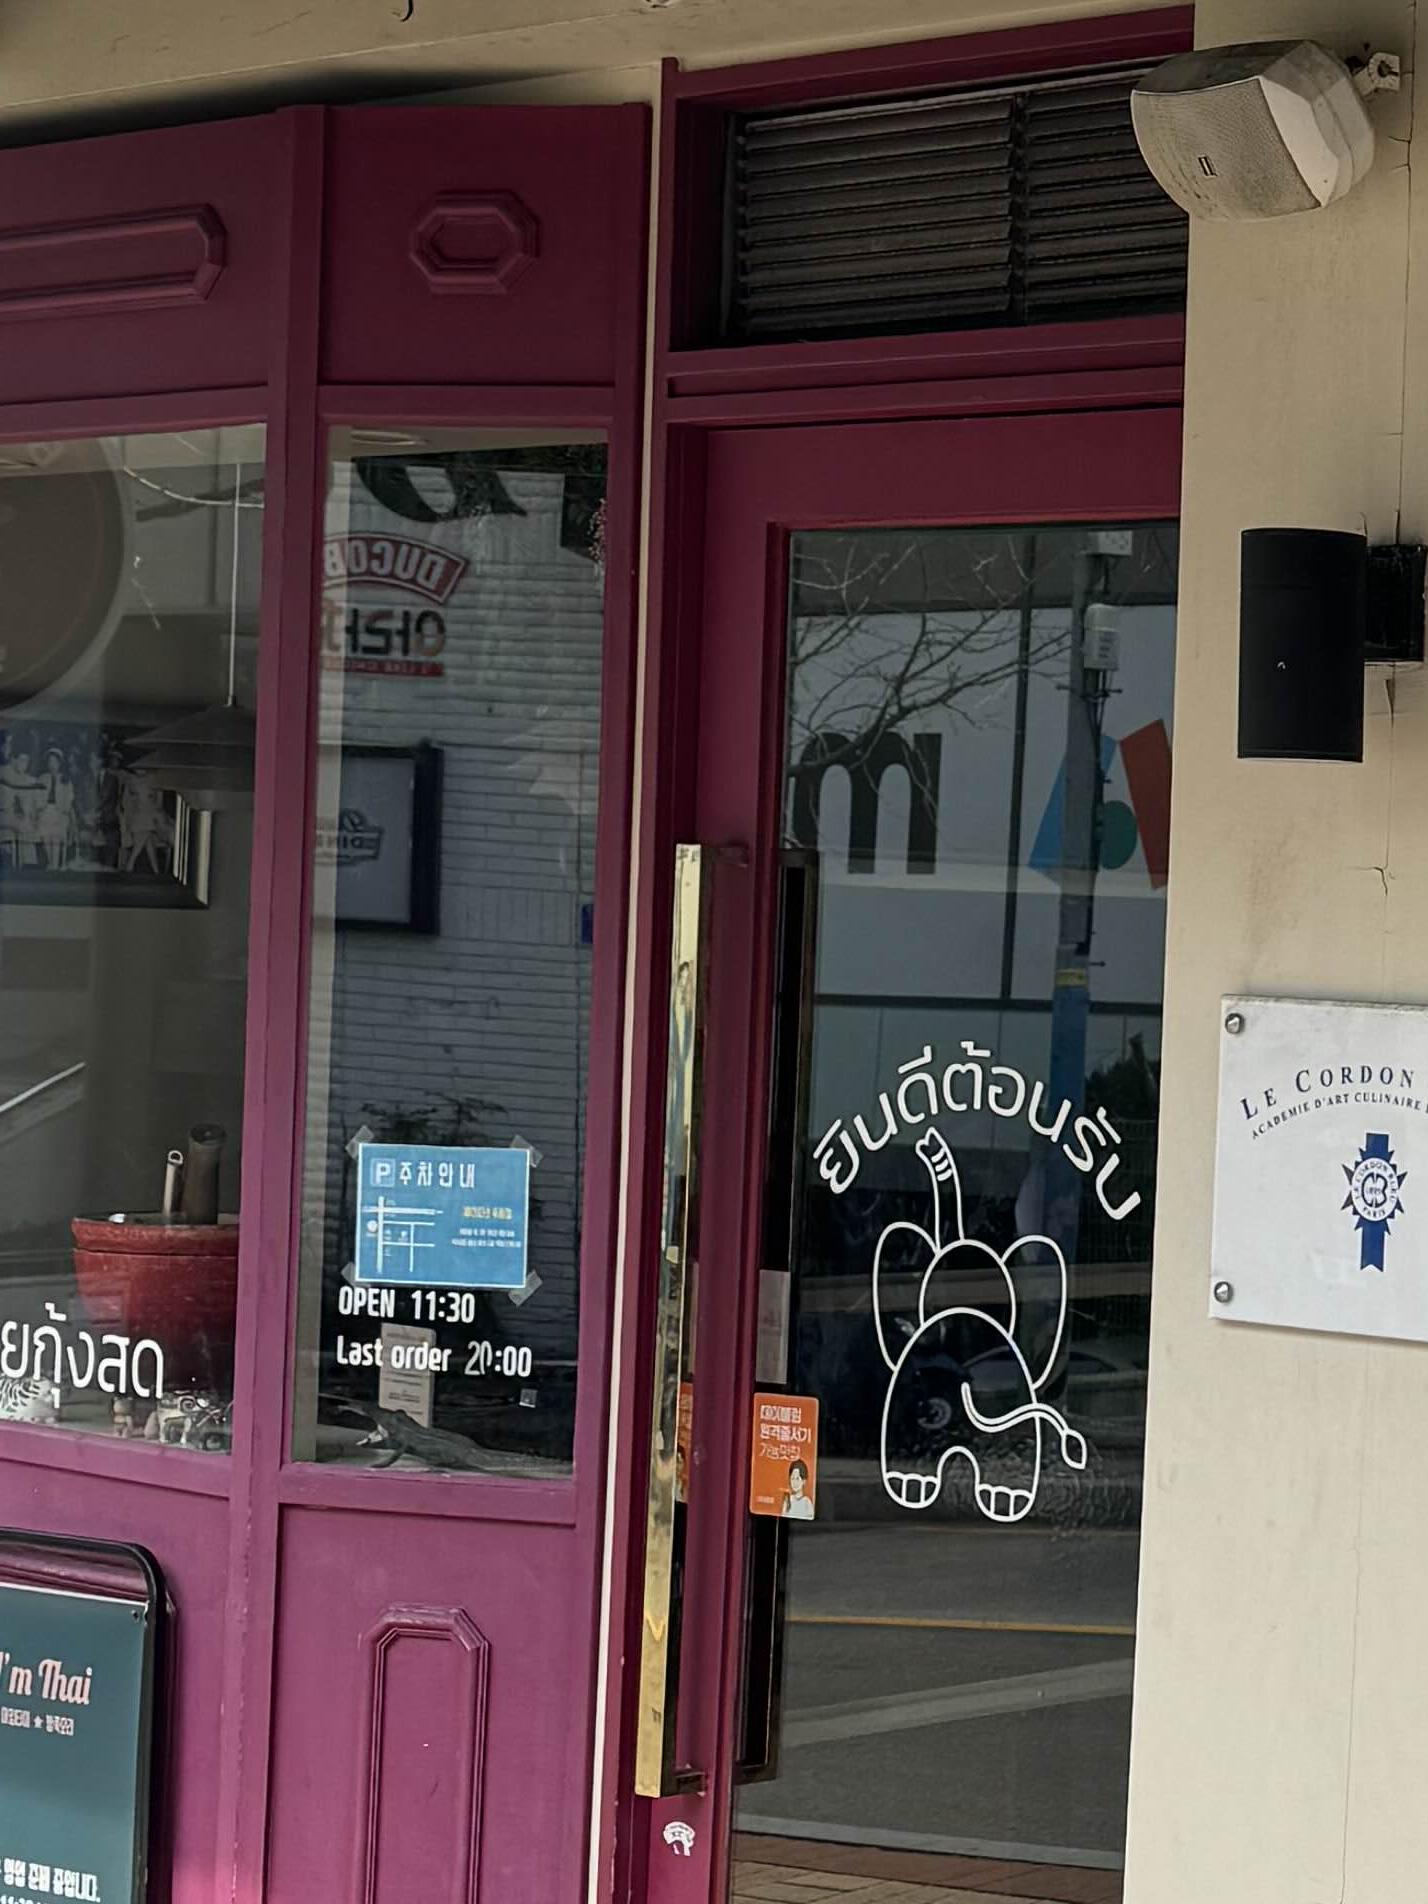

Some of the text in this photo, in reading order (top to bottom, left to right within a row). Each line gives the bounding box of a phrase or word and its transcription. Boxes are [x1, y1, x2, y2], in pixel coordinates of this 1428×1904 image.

[1240, 1088, 1278, 1120] LE
[1295, 1065, 1415, 1093] CORDON
[815, 1041, 1142, 1220] ยินดีต้อนรับ
[338, 1286, 475, 1323] OPEN 11:30
[1, 1302, 165, 1409] ยกุ้งสด
[336, 1335, 384, 1367] Last
[391, 1341, 452, 1372] order
[38, 1658, 93, 1706] Thai
